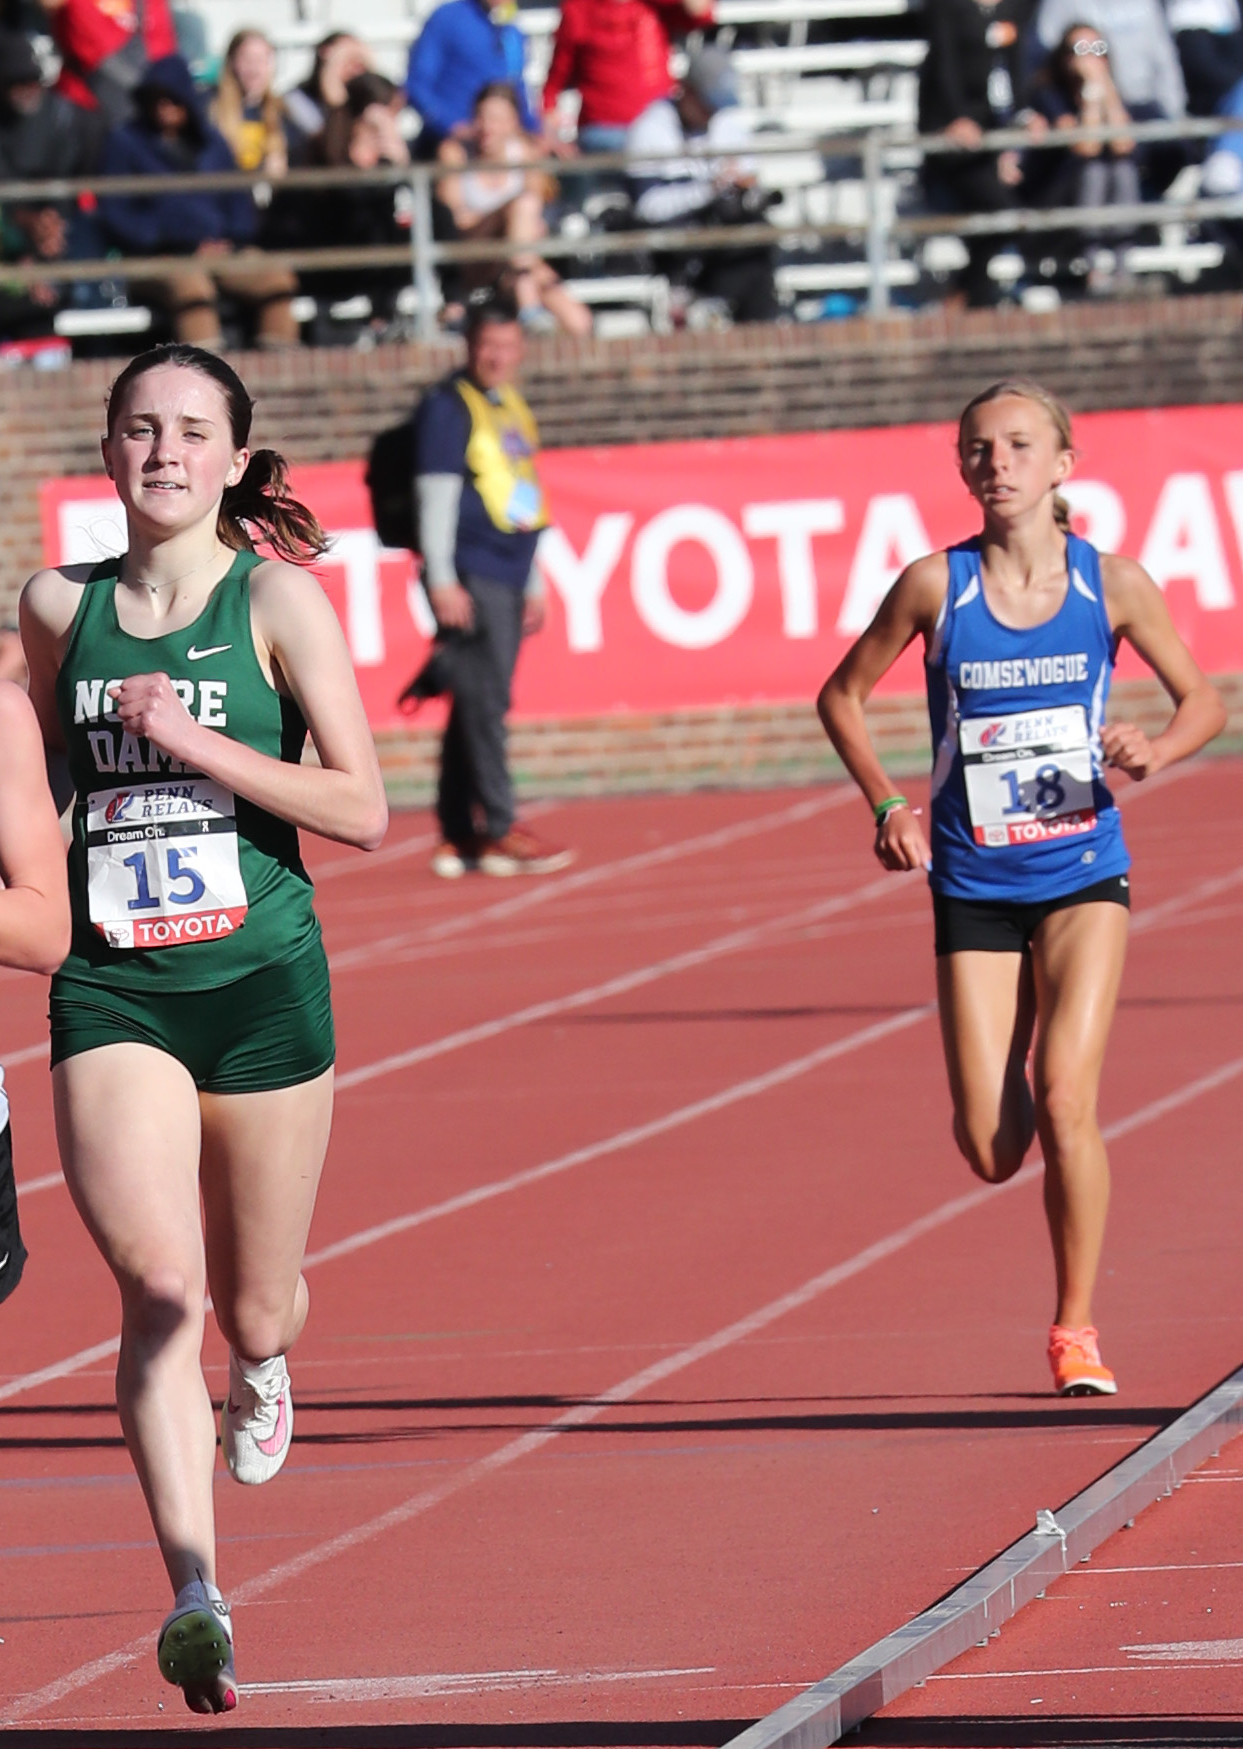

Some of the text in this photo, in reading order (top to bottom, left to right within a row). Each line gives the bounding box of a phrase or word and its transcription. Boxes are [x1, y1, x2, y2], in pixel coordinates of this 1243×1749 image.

[304, 493, 932, 668] TYOTA
[960, 652, 1089, 690] COMSEWOGUE
[73, 679, 228, 727] NORE
[1014, 715, 1054, 731] PENN
[1014, 725, 1069, 742] RELAYS
[87, 730, 204, 774] DAM
[143, 785, 196, 803] PENN
[999, 763, 1066, 815] 18
[141, 799, 214, 817] RELAYS
[108, 830, 144, 844] Dream
[123, 846, 206, 911] 15
[138, 913, 234, 942] TOYOTA
